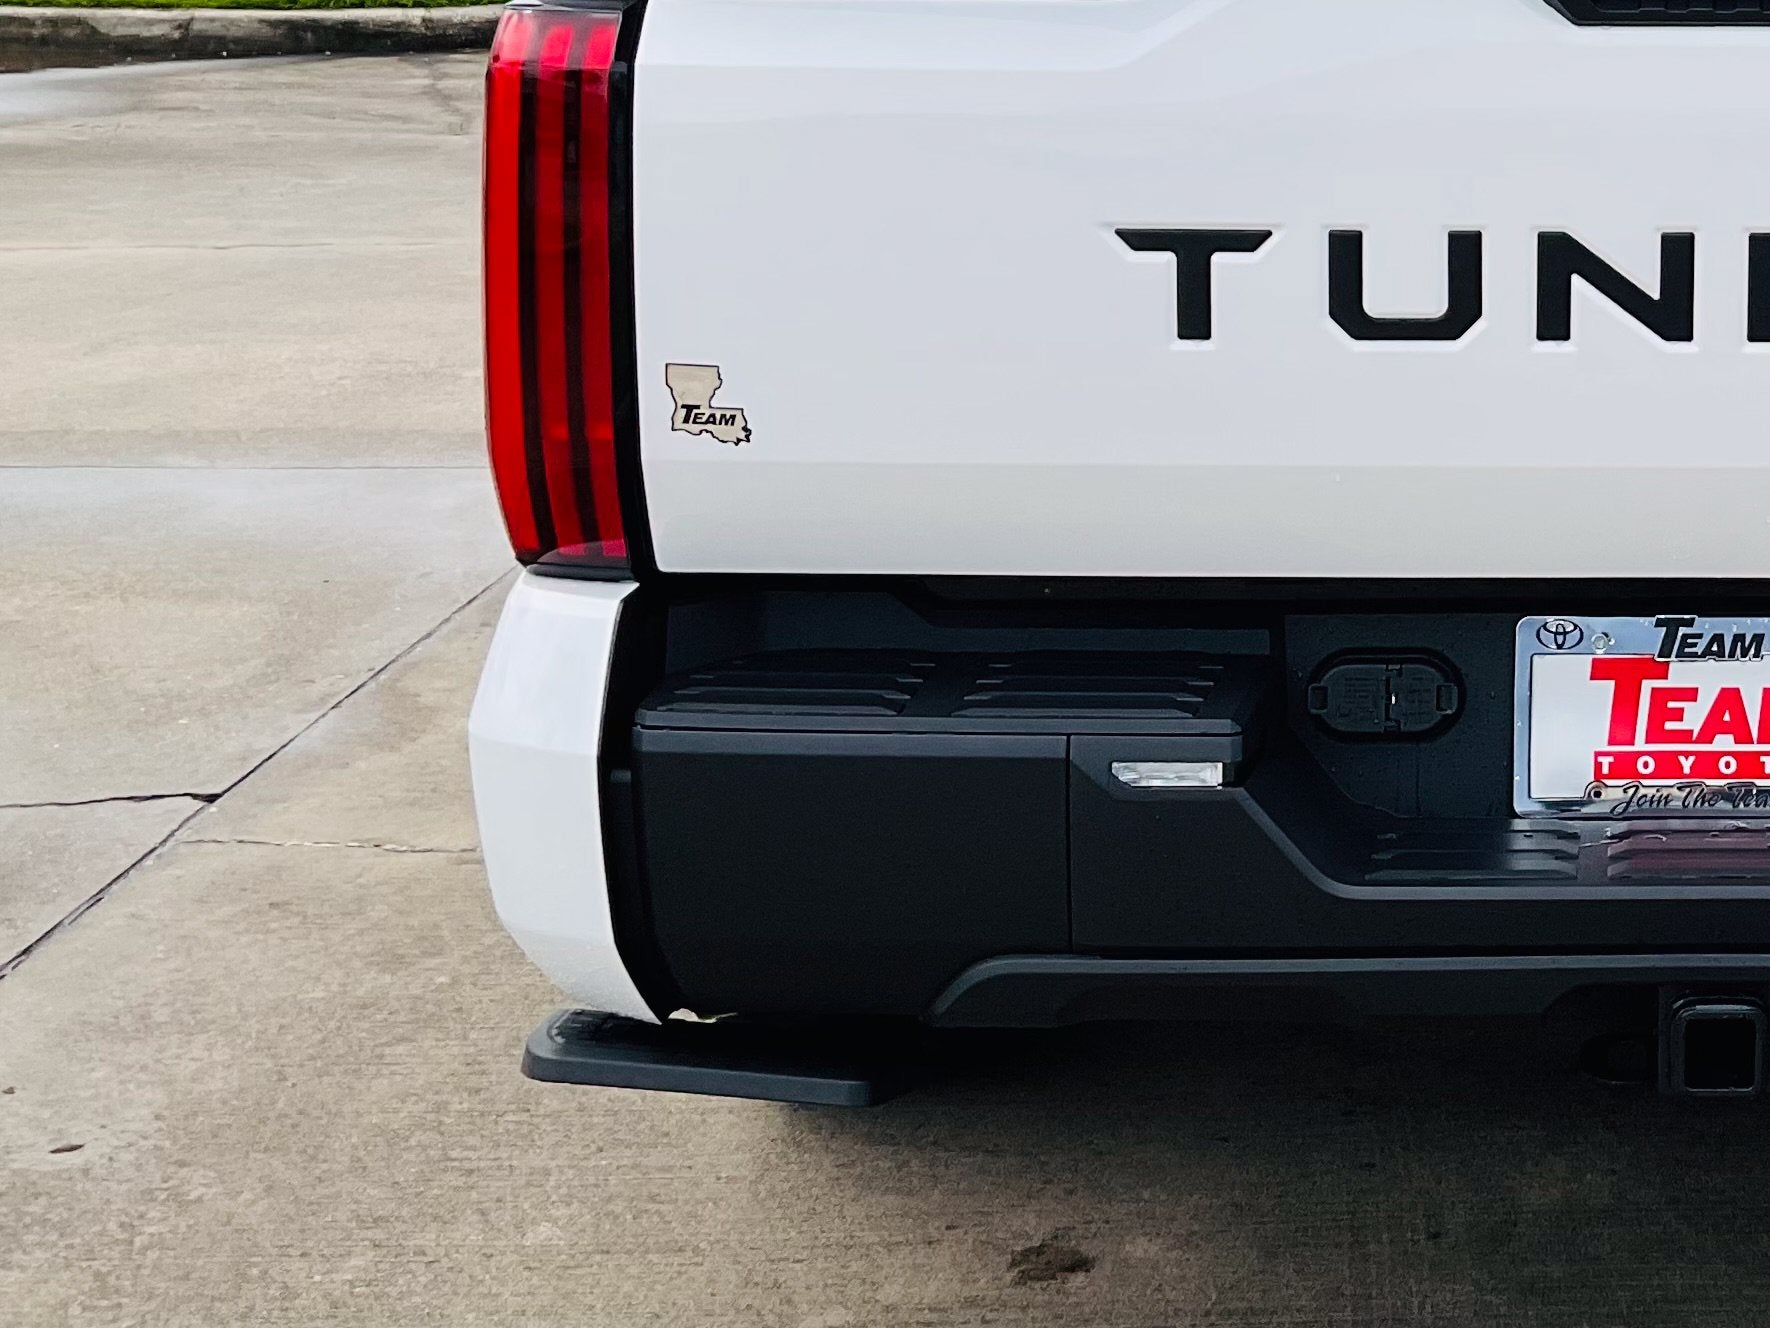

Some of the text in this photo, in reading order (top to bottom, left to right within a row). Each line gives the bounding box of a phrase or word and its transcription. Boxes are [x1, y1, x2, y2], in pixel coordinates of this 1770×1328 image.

[681, 403, 737, 427] TEAM
[1654, 616, 1766, 661] TEAM
[1610, 782, 1672, 816] Join
[1674, 782, 1723, 810] The
